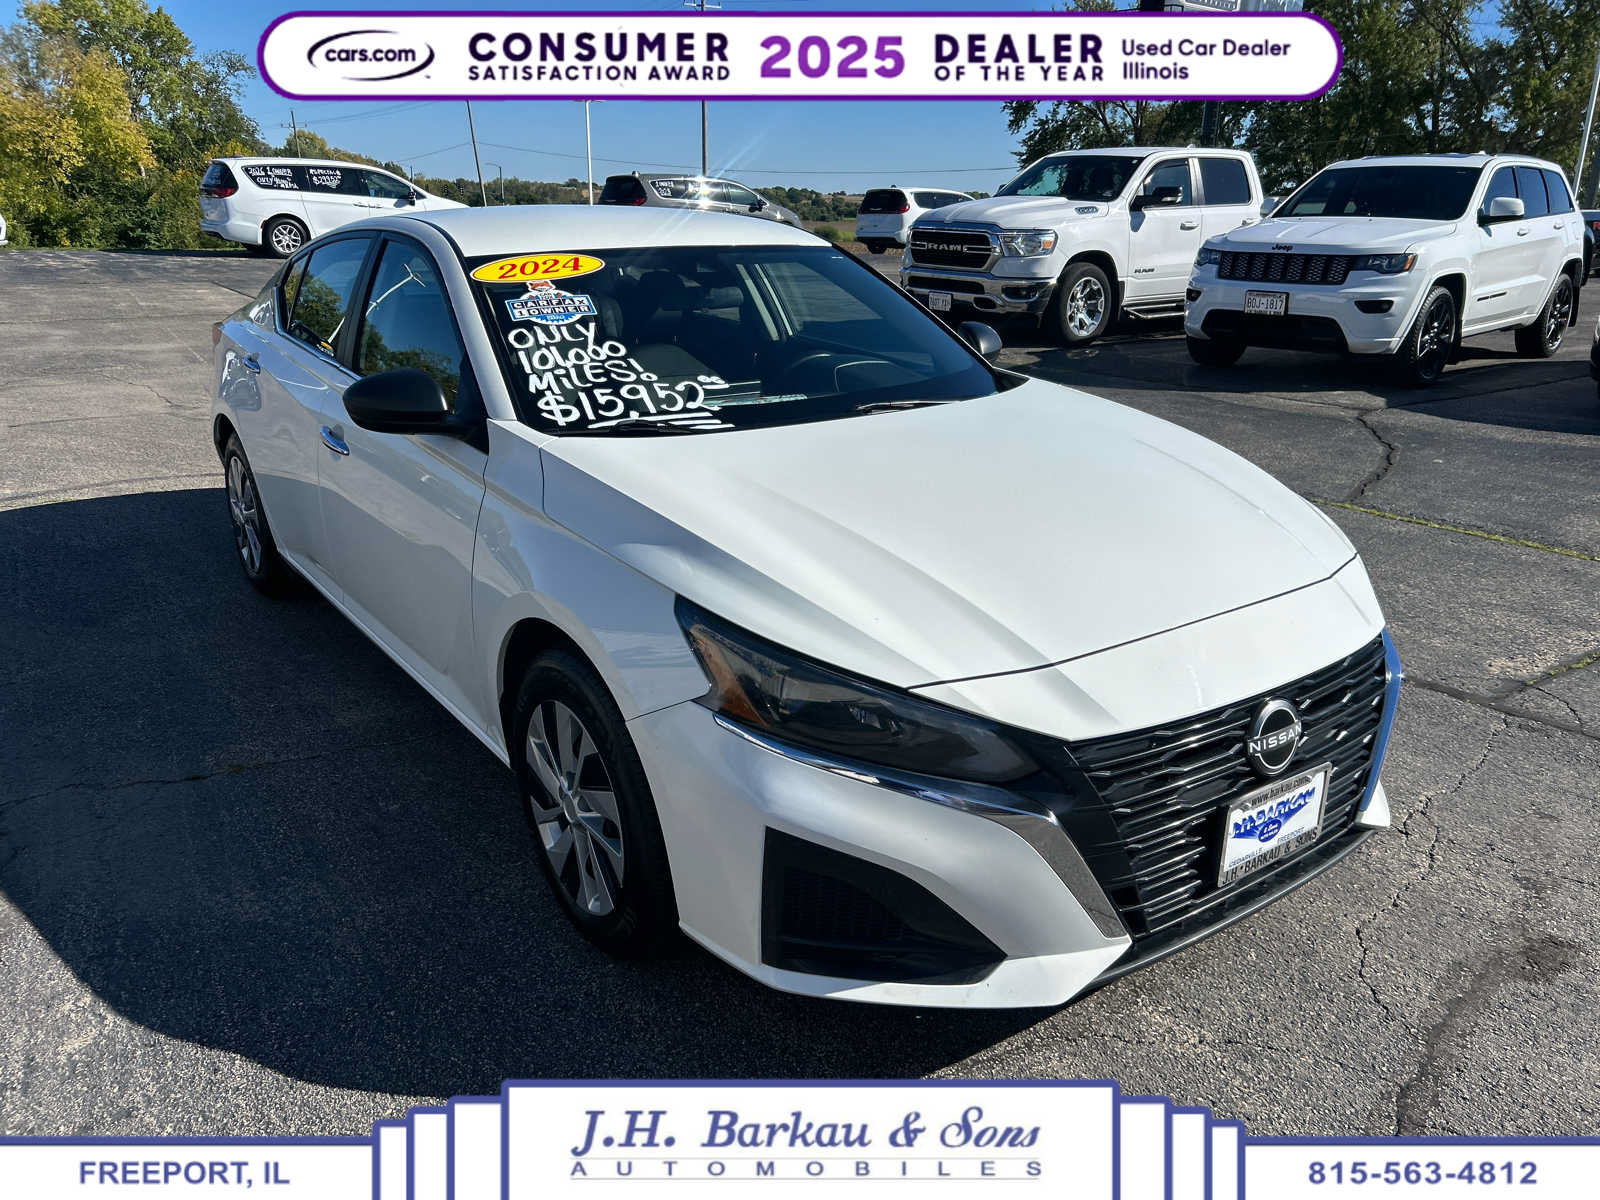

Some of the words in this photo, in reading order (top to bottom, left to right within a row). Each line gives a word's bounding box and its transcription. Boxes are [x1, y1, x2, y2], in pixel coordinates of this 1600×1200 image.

[927, 243, 962, 252] RAM
[1272, 244, 1293, 252] Jeep
[498, 257, 583, 279] 2024
[512, 297, 587, 310] CARFAX
[508, 322, 596, 349] ONLY
[1249, 723, 1302, 753] NISSAN
[1244, 845, 1281, 874] BARKAU
[1295, 826, 1319, 848] SONS
